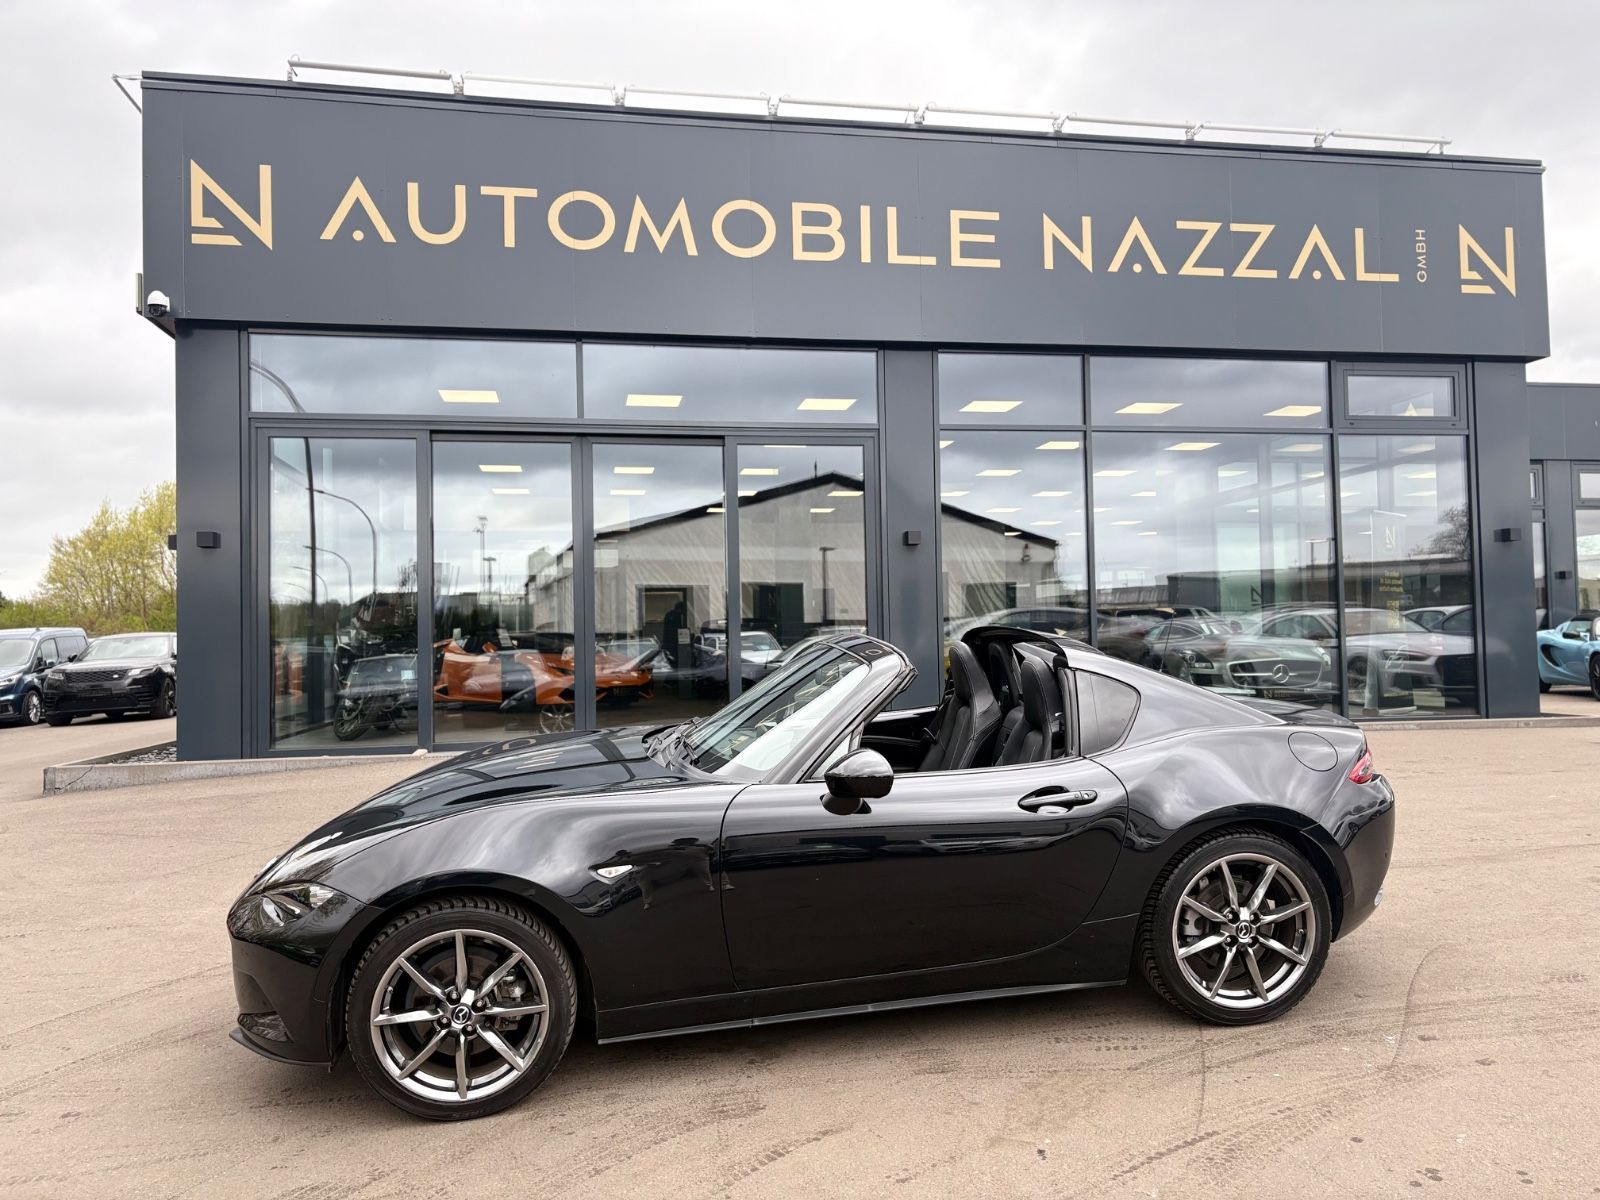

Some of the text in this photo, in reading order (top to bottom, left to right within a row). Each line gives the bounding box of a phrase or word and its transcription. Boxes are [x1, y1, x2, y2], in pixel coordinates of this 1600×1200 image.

[320, 175, 1400, 284] AUTOMOBILE NAZZAL
[1415, 229, 1427, 283] GMBH
